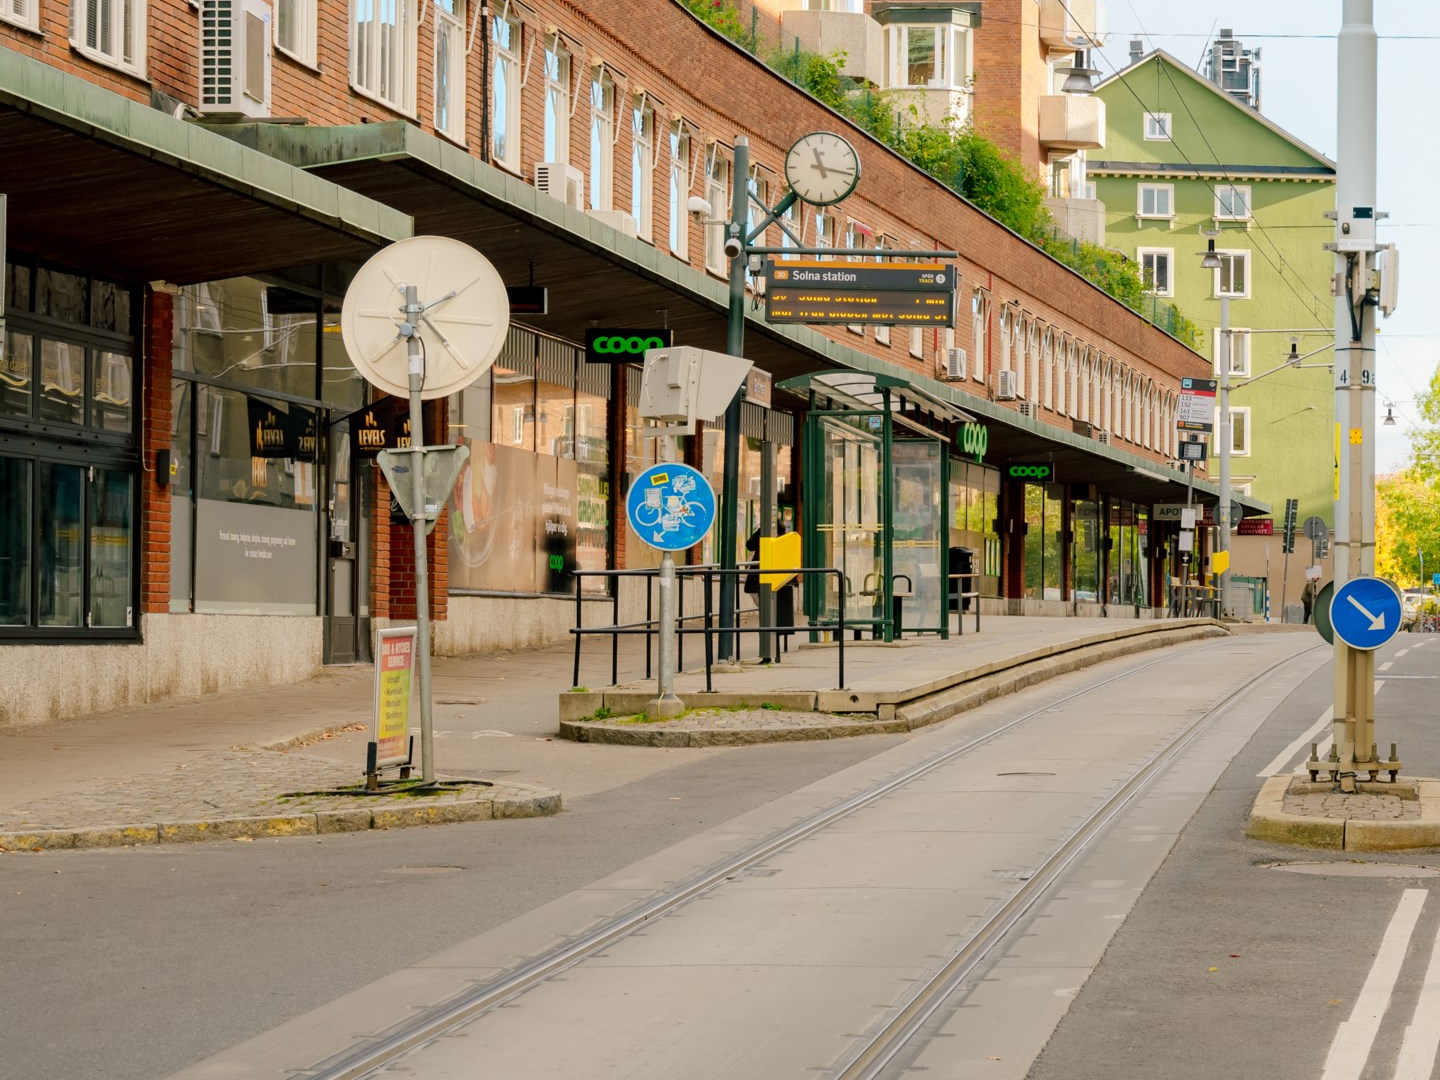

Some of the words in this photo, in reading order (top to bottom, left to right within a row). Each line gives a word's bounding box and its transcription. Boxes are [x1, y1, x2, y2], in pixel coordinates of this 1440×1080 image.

[793, 270, 820, 281] Solna
[822, 271, 856, 282] station
[593, 336, 664, 358] coop
[359, 430, 385, 446] LEVELS
[964, 422, 987, 463] coop
[1009, 466, 1049, 479] coop
[550, 554, 564, 573] coop
